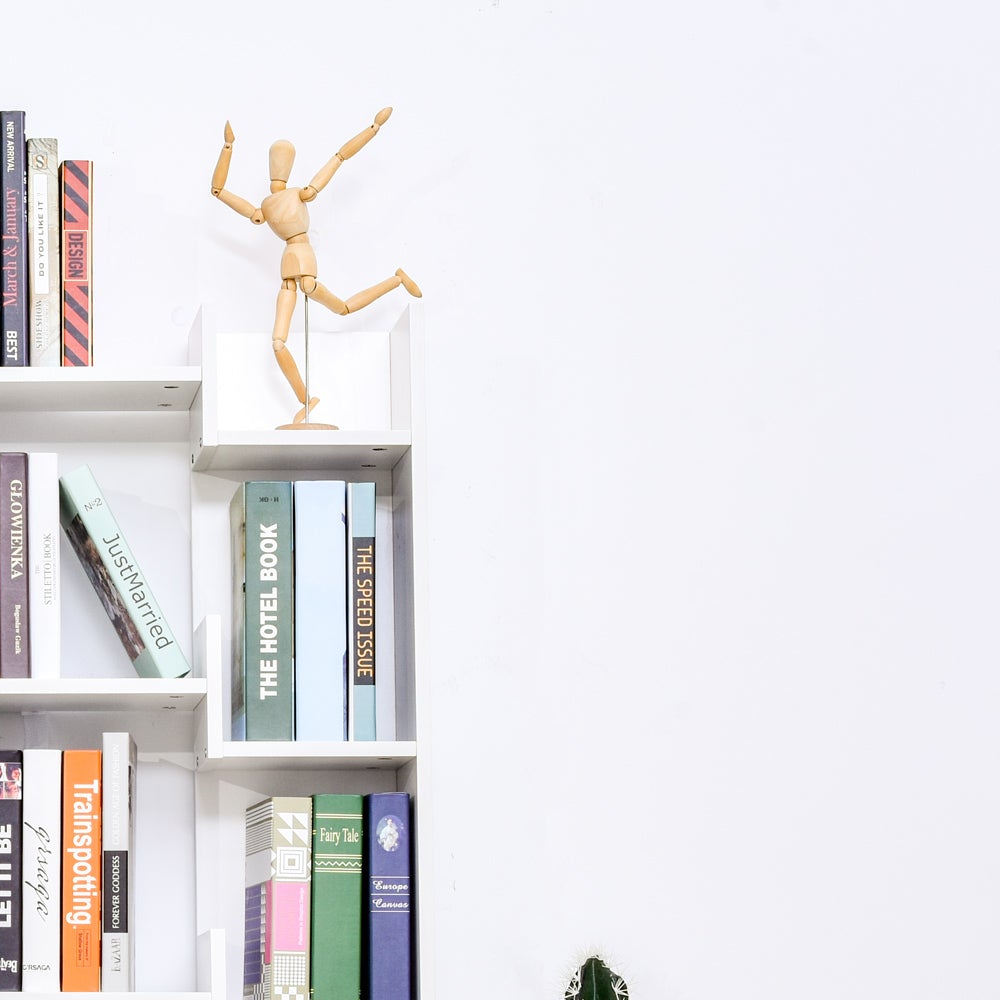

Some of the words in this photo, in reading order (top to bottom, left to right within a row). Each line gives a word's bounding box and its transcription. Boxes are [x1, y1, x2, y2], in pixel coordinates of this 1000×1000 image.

[6, 121, 14, 139] NEW
[6, 140, 15, 172] ARRIVAL
[2, 187, 20, 243] January
[2, 246, 17, 257] &
[38, 262, 45, 277] DO
[67, 232, 84, 278] DESIGN
[2, 261, 18, 307] March
[6, 330, 18, 361] BEST
[10, 479, 24, 580] GLOWIENKA
[43, 533, 52, 560] BOOK
[260, 523, 278, 581] BOOK
[356, 545, 372, 575] THE
[43, 563, 53, 606] STILETTO
[102, 533, 174, 650] JustMarried
[357, 579, 373, 627] SPEED
[260, 587, 278, 654] HOTEL
[357, 631, 373, 678] ISSUE
[260, 660, 278, 700] THE
[320, 827, 339, 846] Fairy
[342, 828, 359, 842] Tale
[111, 855, 121, 893] GODDESS
[372, 880, 409, 892] Europe
[111, 894, 121, 929] FOREVER
[372, 898, 409, 909] Canvas
